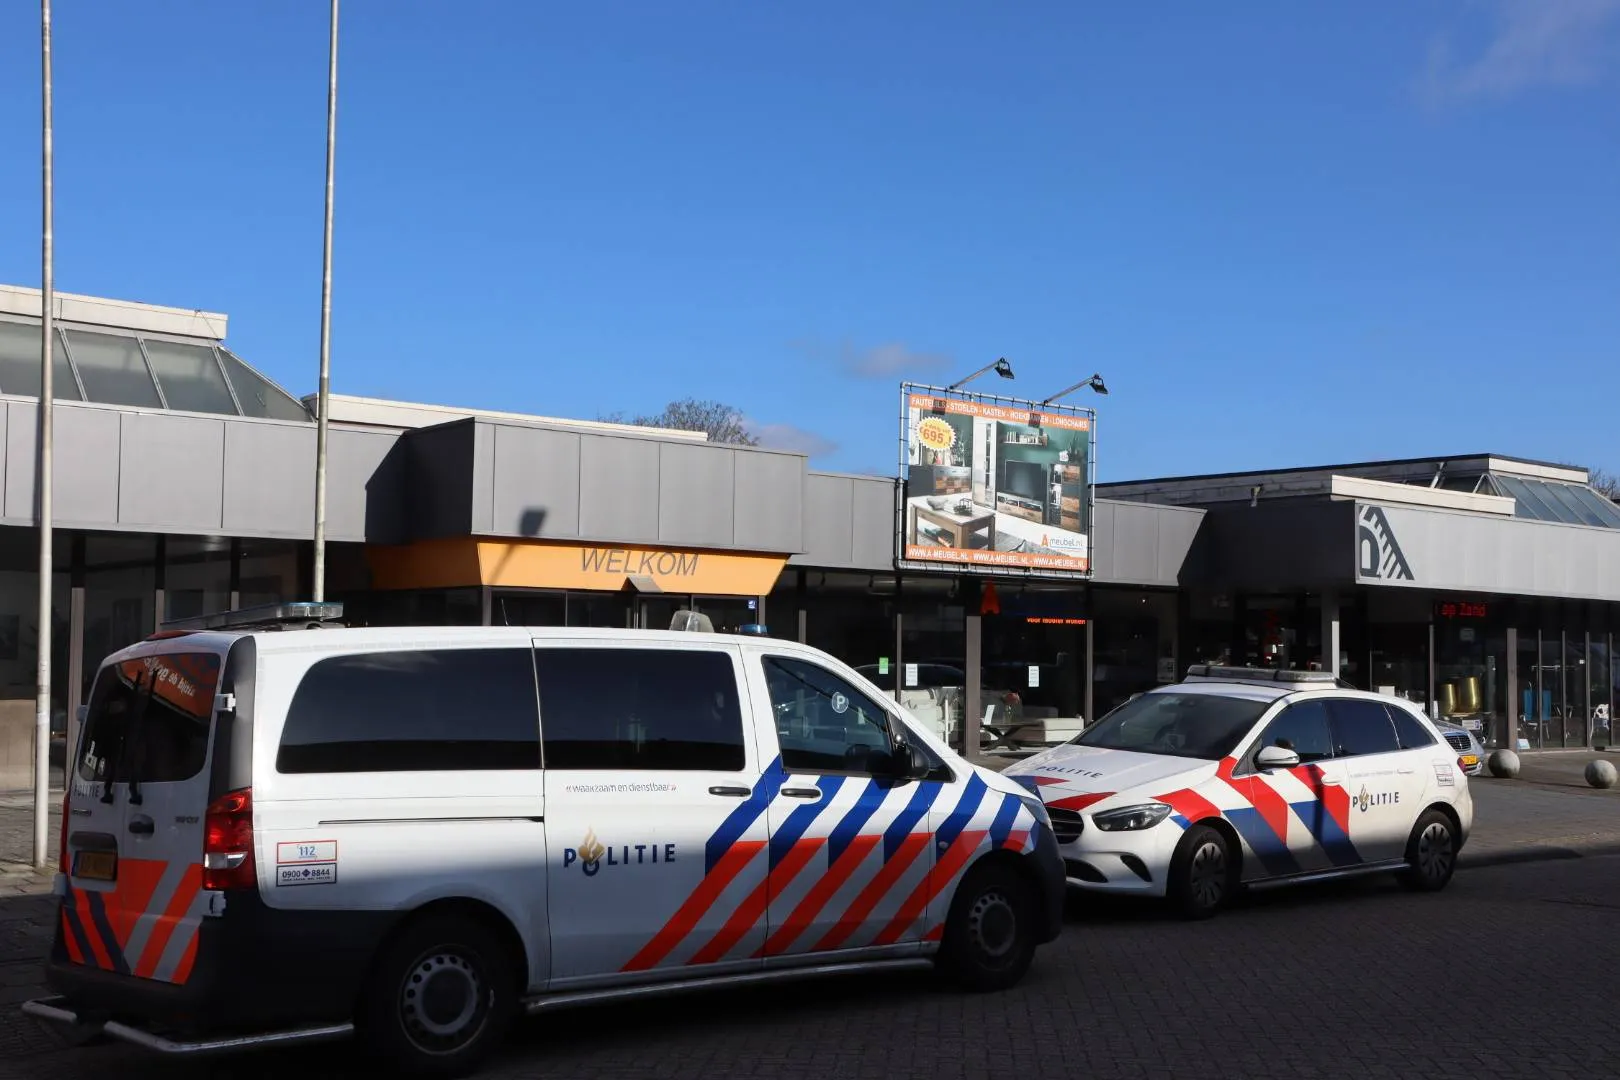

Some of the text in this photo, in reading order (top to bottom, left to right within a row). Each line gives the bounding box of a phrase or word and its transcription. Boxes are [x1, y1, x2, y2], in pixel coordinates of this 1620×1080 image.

[951, 402, 978, 413] STOELEN
[983, 407, 1006, 417] KASTEN
[581, 547, 699, 576] WELKOM
[1036, 765, 1104, 779] POLITIE
[617, 783, 628, 792] en
[298, 846, 316, 856] 112
[563, 843, 676, 877] POLITIE
[282, 868, 330, 879] 0900 8844
